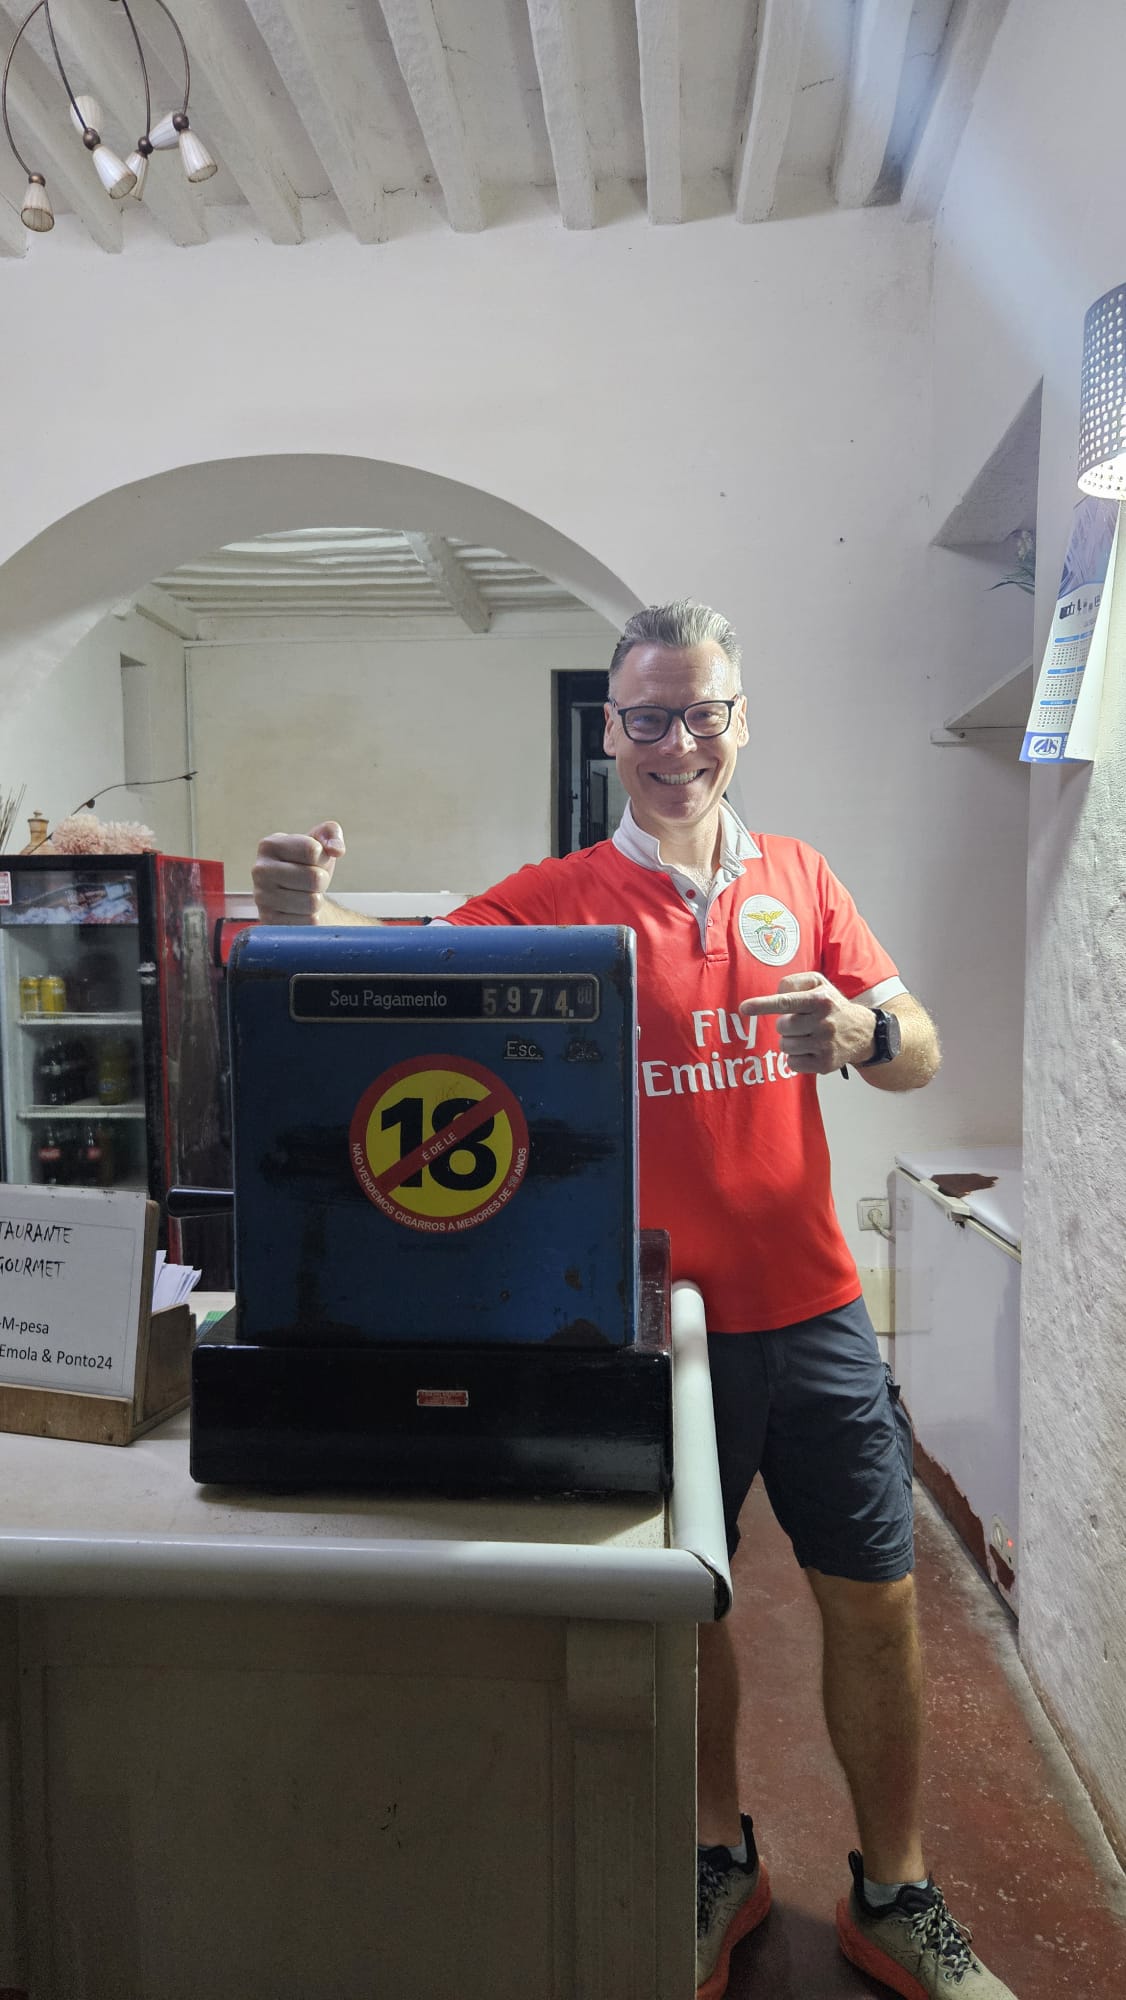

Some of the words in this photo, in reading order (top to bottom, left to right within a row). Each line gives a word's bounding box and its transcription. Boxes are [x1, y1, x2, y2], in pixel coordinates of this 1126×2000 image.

[329, 990, 358, 1007] Seu
[363, 990, 448, 1010] Pagamento
[691, 1008, 758, 1050] Fly
[641, 1049, 799, 1097] Emirate
[381, 1097, 497, 1192] 18
[429, 1141, 445, 1156] DE
[358, 1165, 395, 1214] VENDEMOS
[395, 1210, 446, 1232] CIGARROS
[448, 1222, 456, 1231] A
[456, 1199, 501, 1230] MENORES
[498, 1187, 512, 1202] DE
[514, 1147, 527, 1177] ANOS
[0, 1220, 73, 1244] TAURANTE
[0, 1343, 38, 1361] Emola
[41, 1348, 52, 1364] &
[57, 1350, 113, 1371] Ponto24
